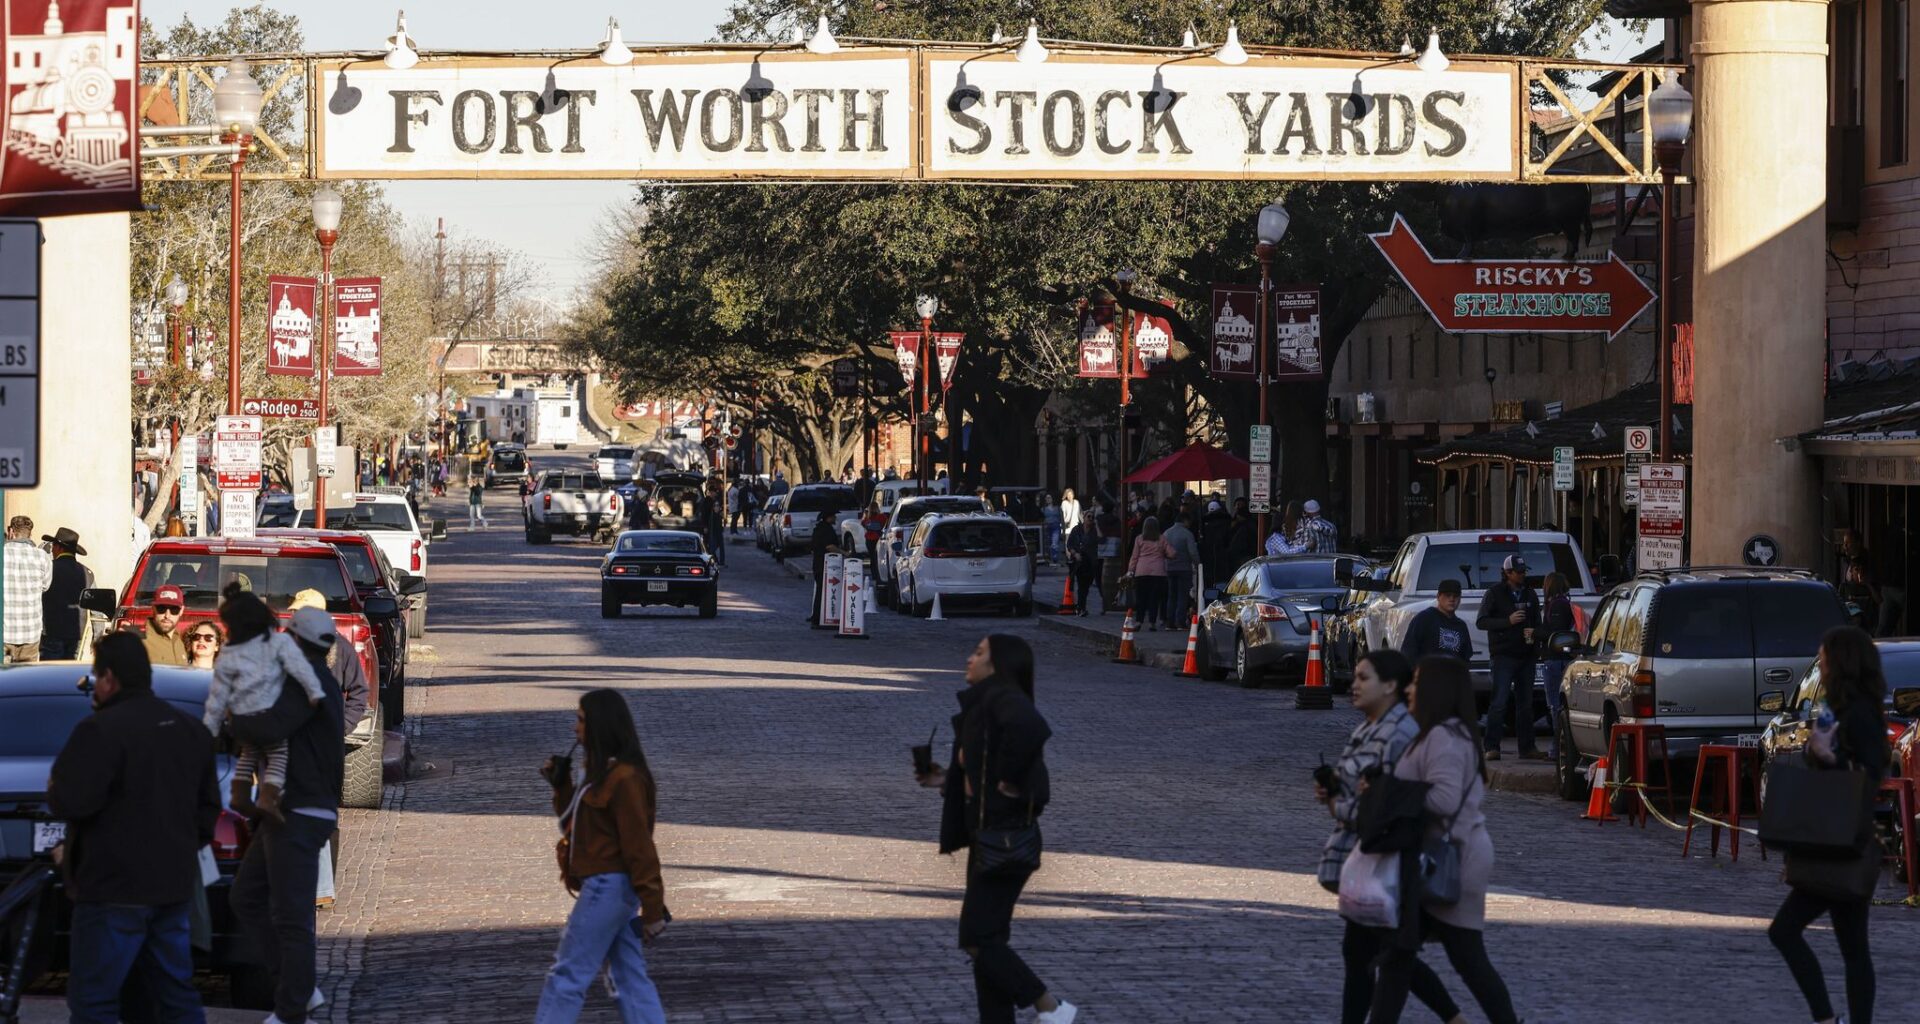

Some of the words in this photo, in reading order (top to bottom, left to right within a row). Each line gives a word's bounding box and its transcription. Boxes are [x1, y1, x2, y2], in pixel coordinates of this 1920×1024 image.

[387, 88, 597, 155] FORT
[631, 88, 889, 154] WORTH
[947, 88, 1193, 157] STOCK
[1227, 90, 1466, 159] YARDS
[1475, 265, 1593, 287] RISCKY'S
[1453, 292, 1612, 318] STEAKHOUSE
[0, 345, 27, 366] BS
[260, 401, 297, 415] Rodeo
[303, 401, 313, 409] Plz
[299, 409, 317, 417] 2500
[1252, 427, 1257, 438] 2
[1555, 450, 1560, 461] 2
[1659, 480, 1682, 489] ENFORCED
[1660, 542, 1681, 550] PARKING
[1646, 551, 1657, 559] ALL
[1658, 551, 1674, 559] OTHER
[1652, 560, 1667, 568] TIMES
[849, 595, 857, 627] VALET
